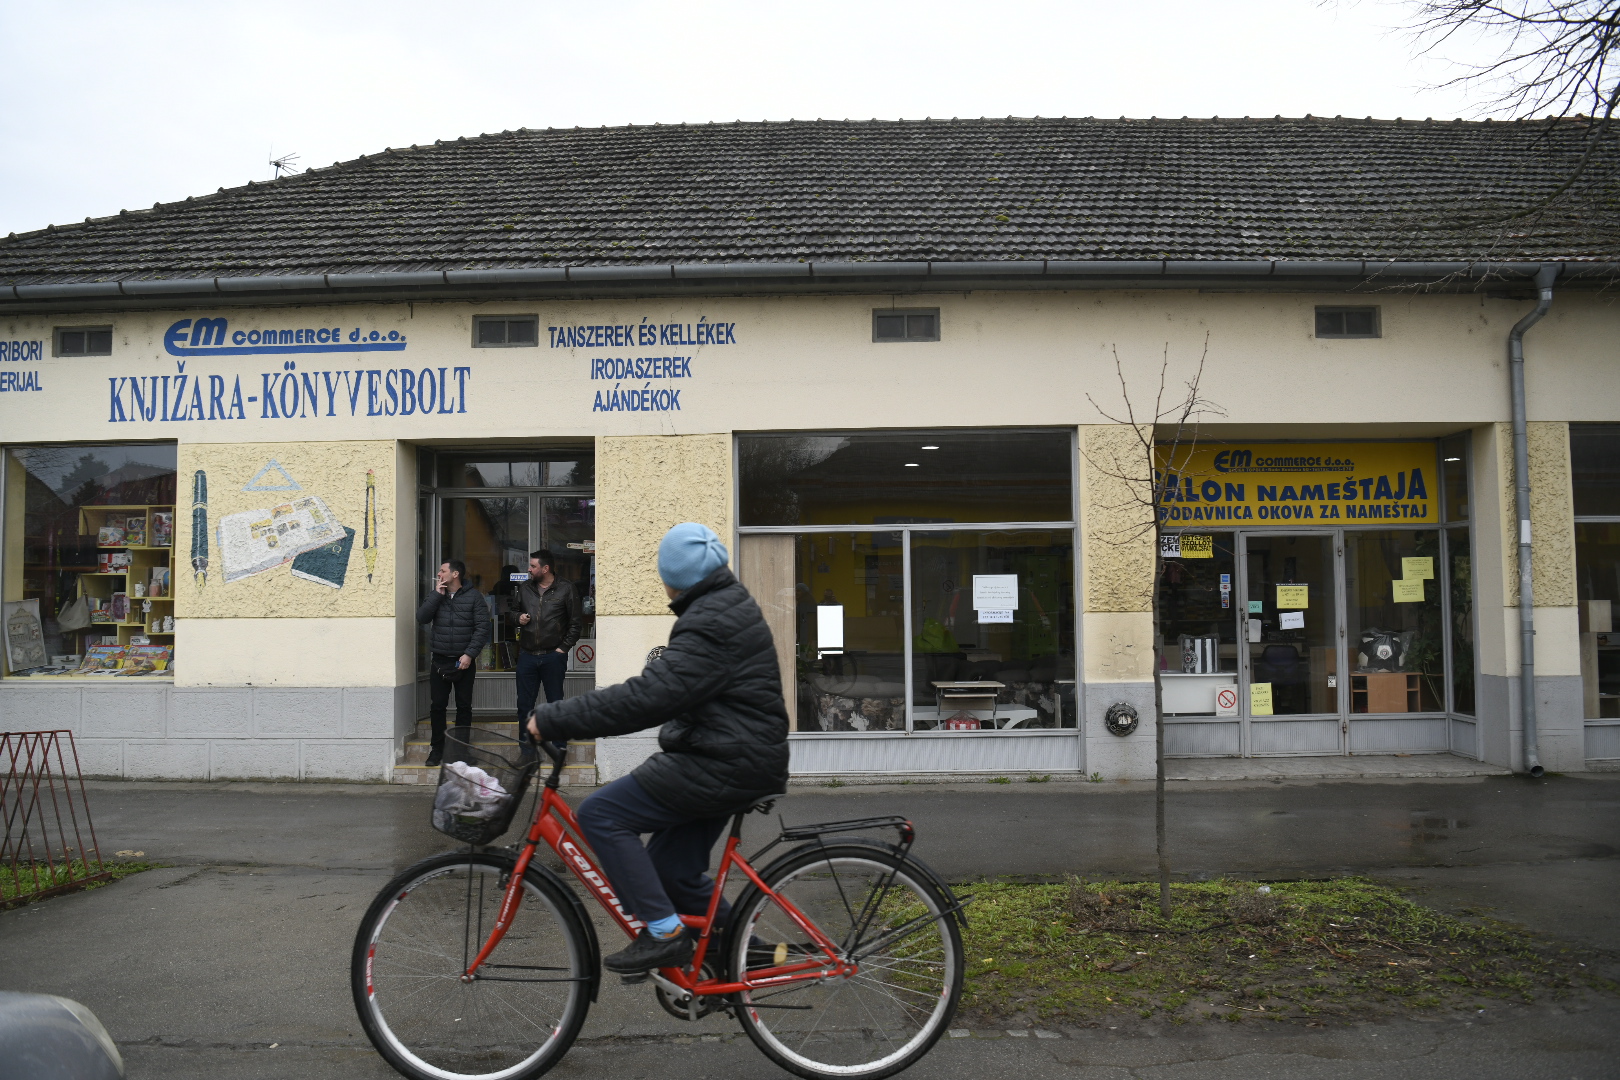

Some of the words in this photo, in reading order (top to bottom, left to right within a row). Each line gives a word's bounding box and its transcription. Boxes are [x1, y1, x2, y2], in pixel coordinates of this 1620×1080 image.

[232, 327, 341, 345] COMMERCE
[349, 327, 407, 343] d.o.o.
[548, 324, 635, 348] TANSZEREK
[638, 317, 657, 346] ÉS
[660, 316, 737, 346] KELLÉKEK
[0, 340, 43, 361] RIBORI
[591, 357, 692, 380] IRODASZEREK
[0, 371, 43, 392] ERIJAL
[108, 361, 471, 422] KNJIŽARA-KÖNYVESBOLT
[592, 382, 681, 412] AJÁNDÉKOK
[1255, 456, 1322, 467] COMMERCE
[1257, 468, 1428, 502] NAMEŠTAJA
[1160, 505, 1254, 520] RODAVNICA
[1258, 504, 1314, 519] OKOVA
[1319, 504, 1341, 519] ZA
[1346, 501, 1428, 519] NAMEŠTAJ
[563, 841, 645, 935] capriol
